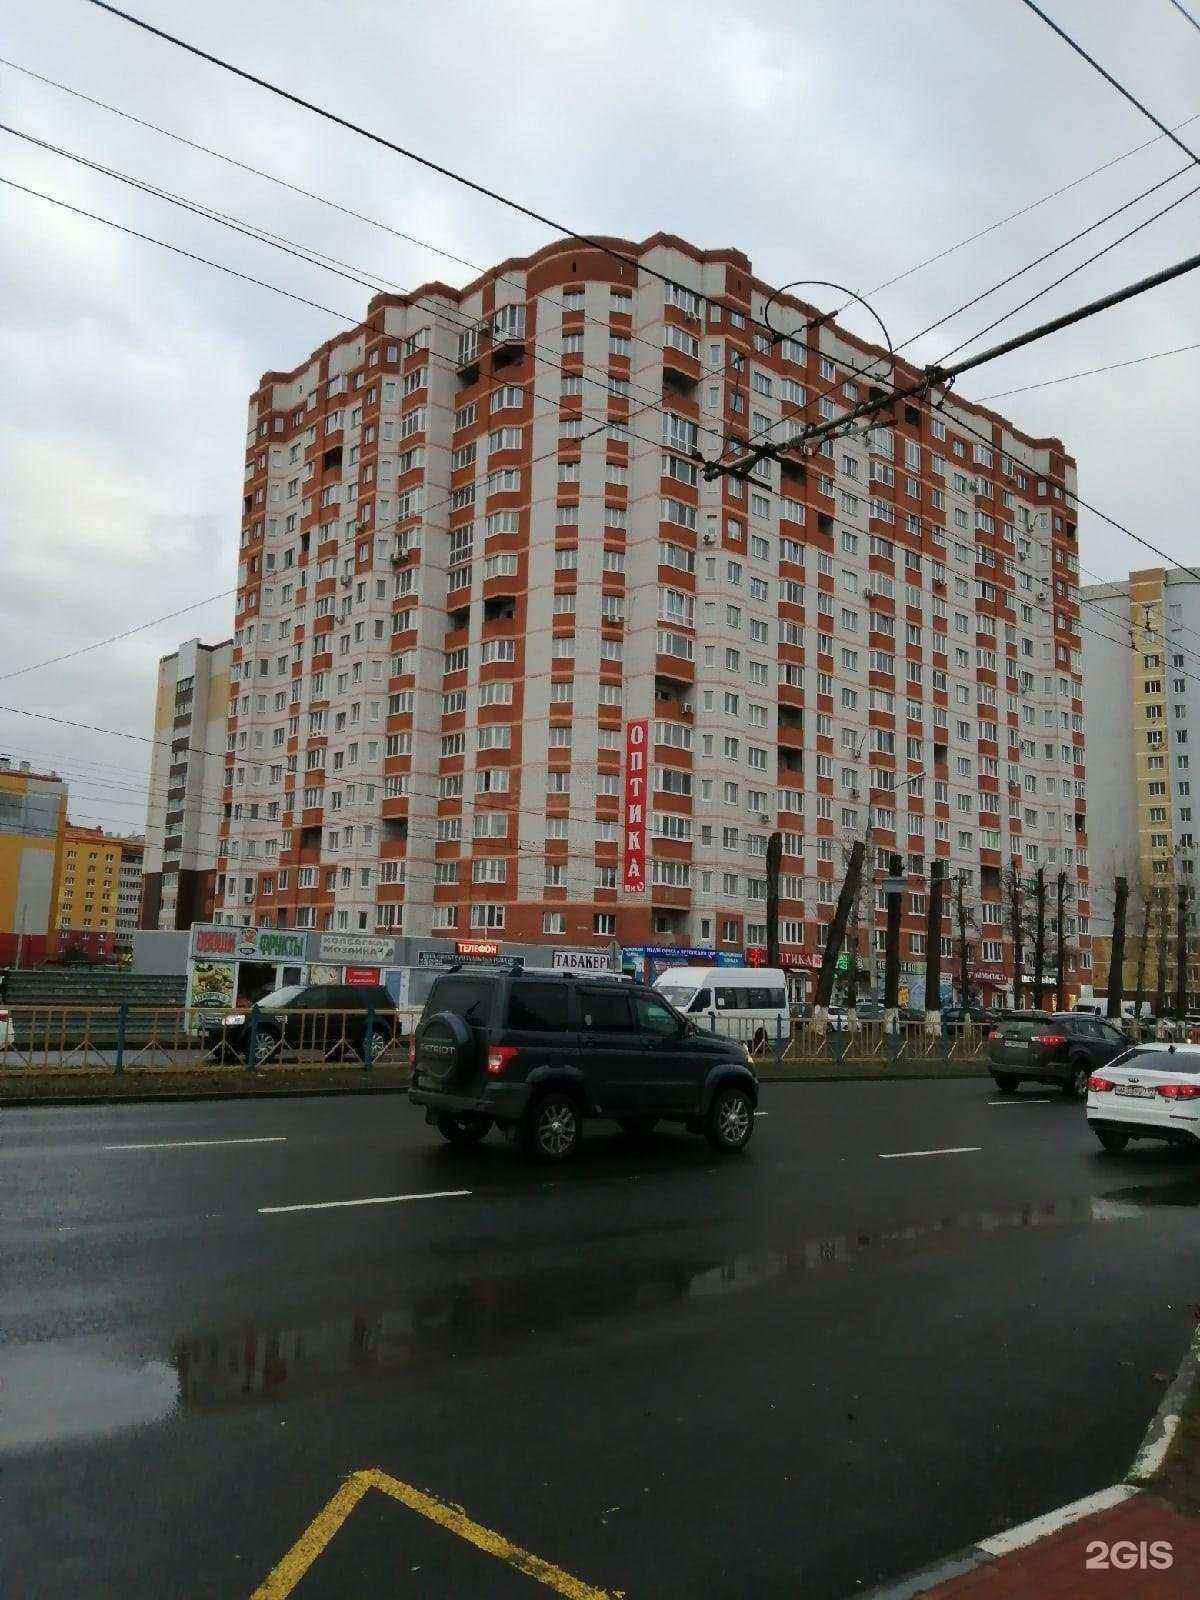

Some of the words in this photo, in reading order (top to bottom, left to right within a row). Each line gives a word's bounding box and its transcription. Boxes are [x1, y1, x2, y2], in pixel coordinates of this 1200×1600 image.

[627, 725, 644, 878] ОПТИКА
[457, 943, 497, 954] ТЕЛЕФОН
[556, 954, 611, 968] ТАБАКЕР
[421, 1044, 455, 1054] TRIOT
